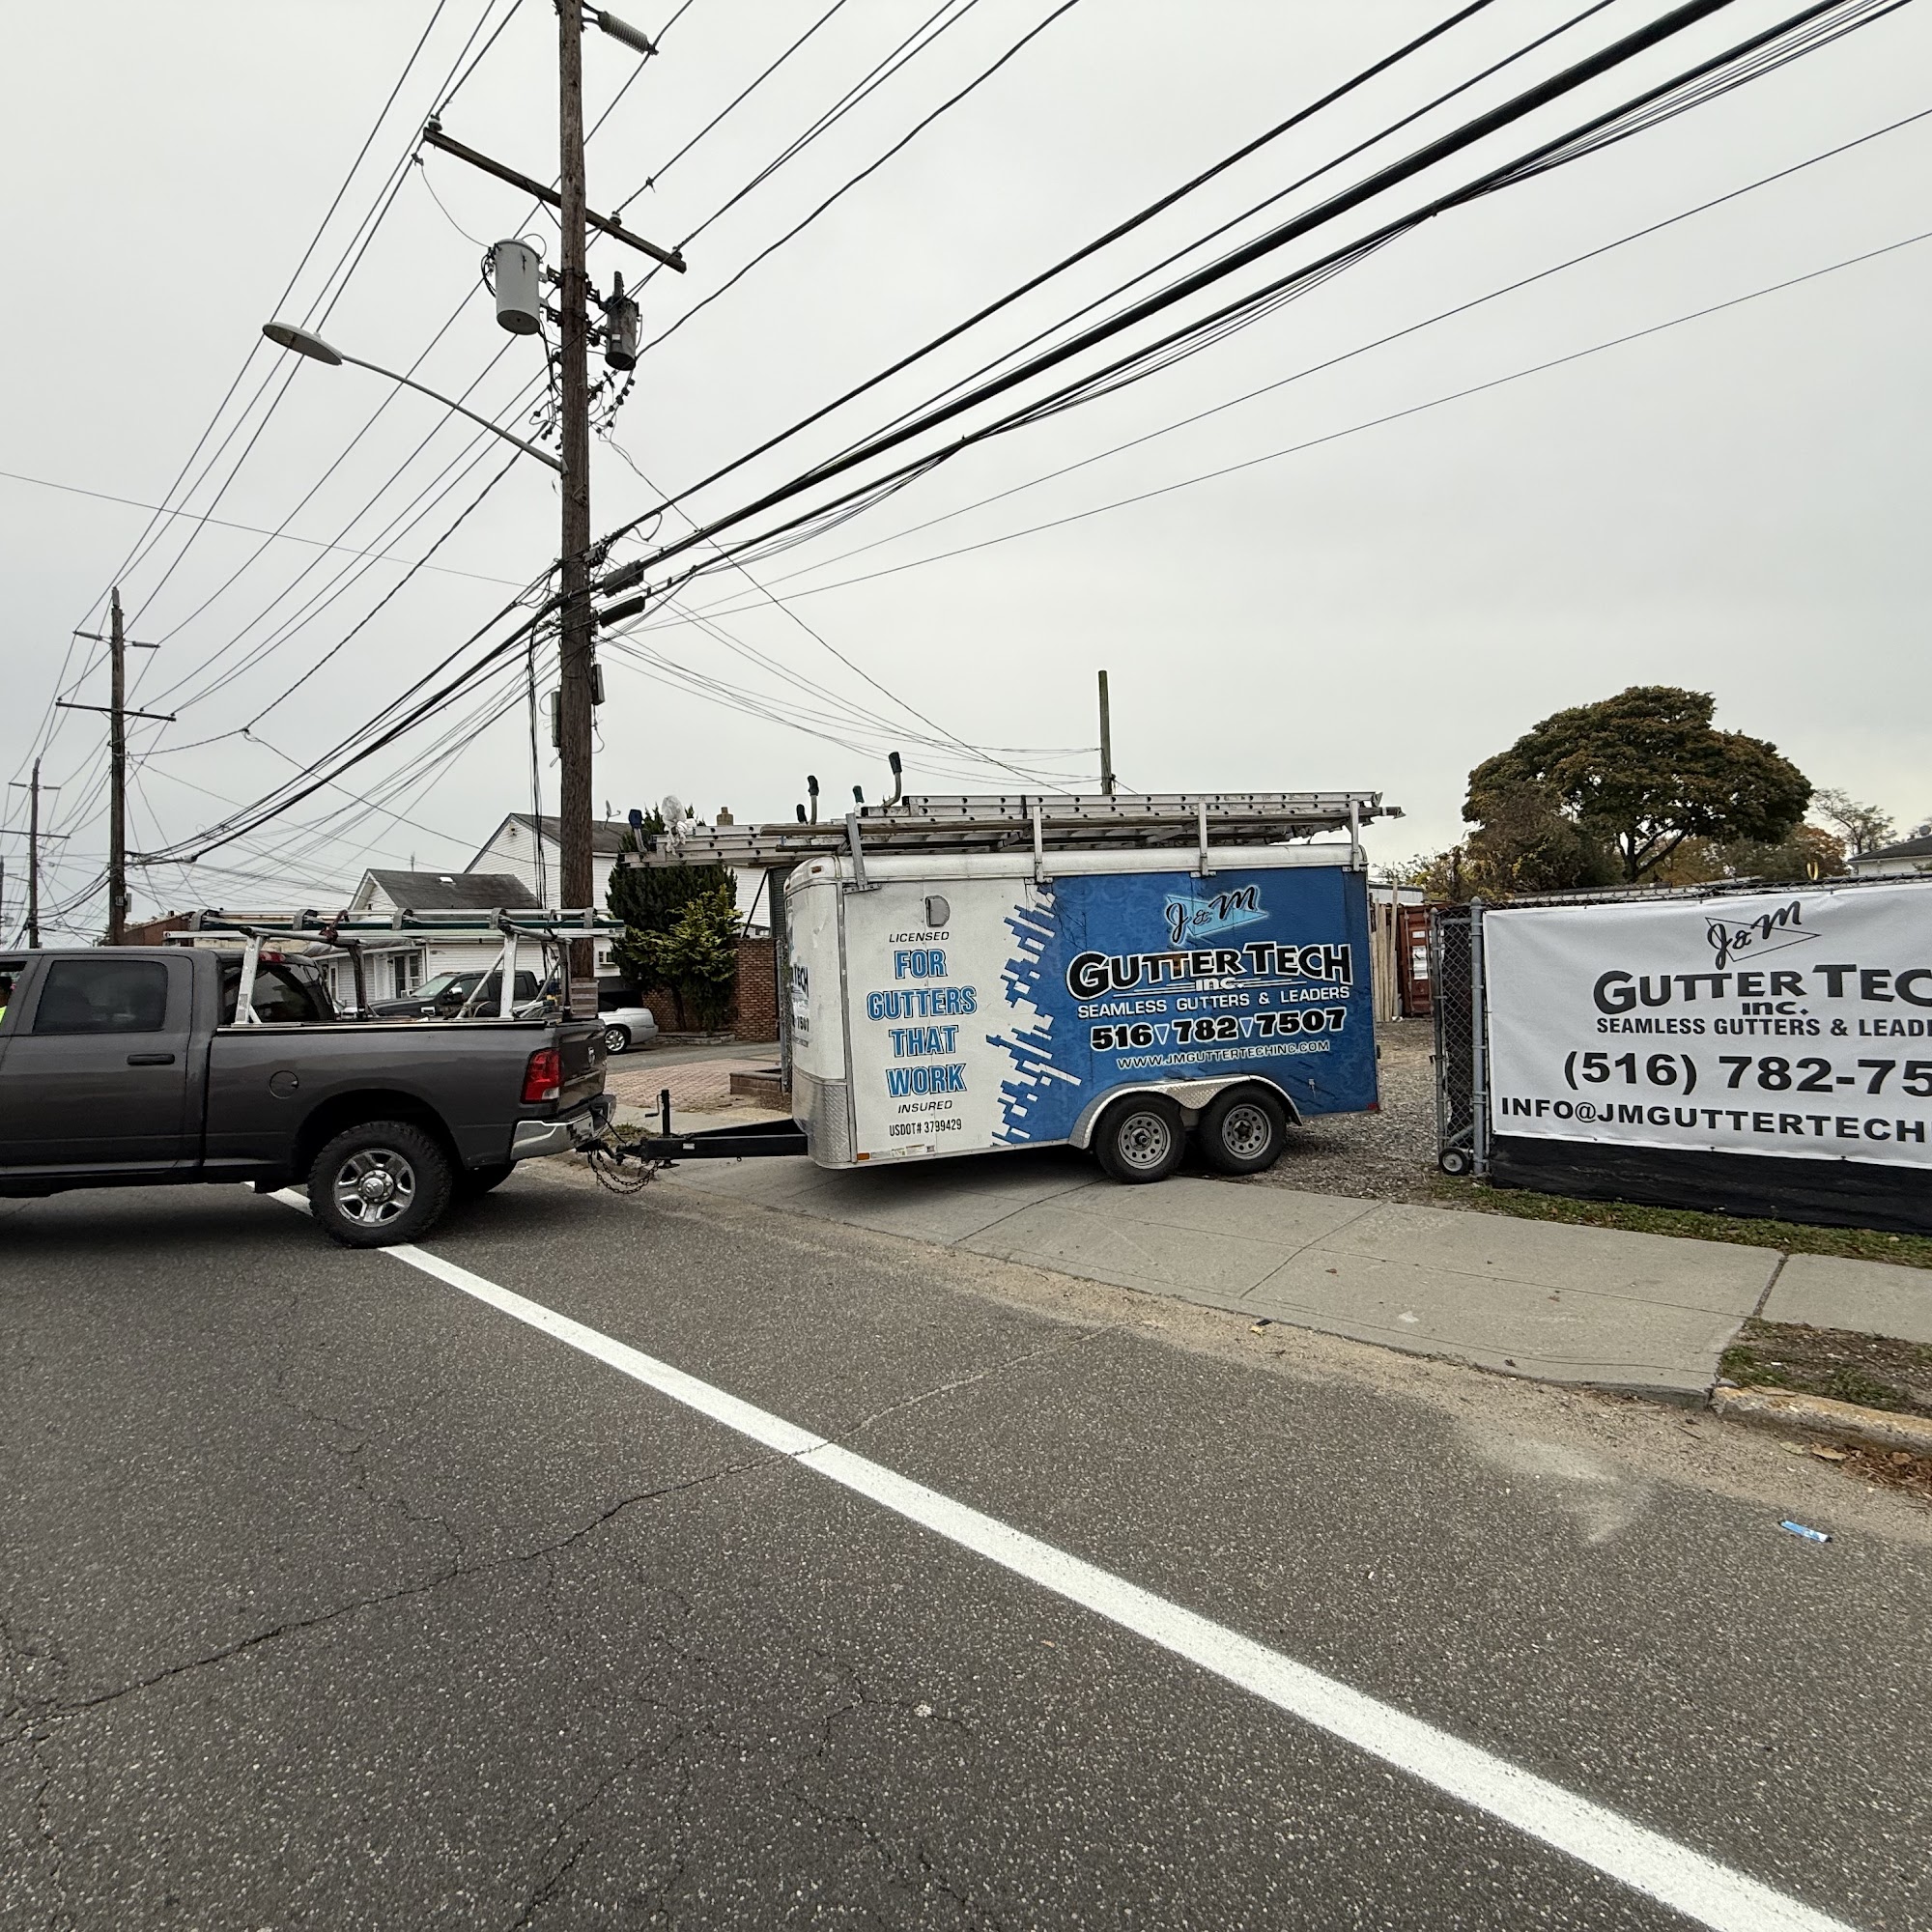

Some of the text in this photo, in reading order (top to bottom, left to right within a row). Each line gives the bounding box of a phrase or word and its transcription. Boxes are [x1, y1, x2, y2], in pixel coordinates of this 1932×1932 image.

[889, 931, 950, 943] LICENSED
[894, 948, 948, 980] FOR
[867, 985, 978, 1021] GUTTERS
[1077, 985, 1350, 1019] SEAMLESS GUTTERS & LEADERS
[889, 1024, 959, 1058] THAT
[1090, 1007, 1347, 1052] 516 782 7507
[1597, 1017, 1706, 1035] SEAMLESS
[1714, 1018, 1821, 1036] GUTTERS
[1830, 1018, 1849, 1037] &
[1116, 1039, 1330, 1070] WWW.JMGUTTERTECHINC.COM
[886, 1063, 967, 1097] WORK
[1564, 1051, 1697, 1095] (516)
[897, 1100, 952, 1114] INSURED
[1501, 1097, 1932, 1143] INFO@JMGUTTERTECH
[889, 1119, 962, 1137] USDOT# 3799429
